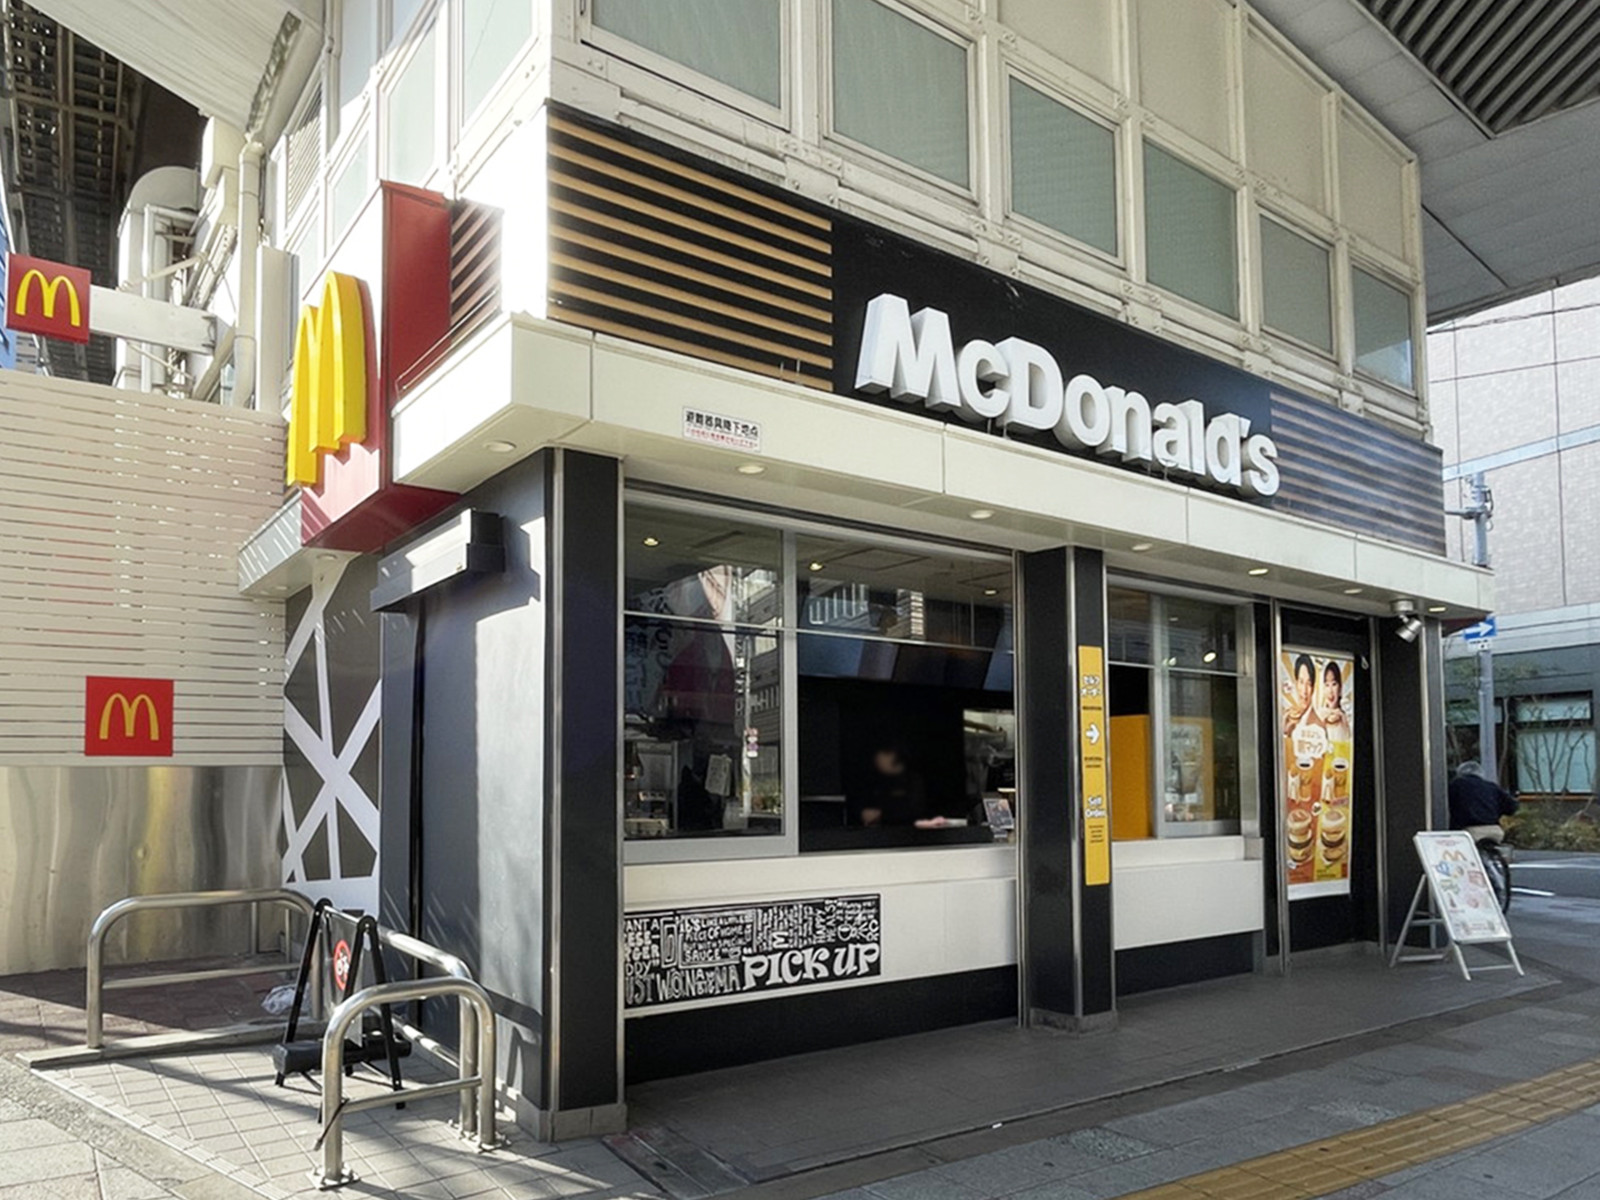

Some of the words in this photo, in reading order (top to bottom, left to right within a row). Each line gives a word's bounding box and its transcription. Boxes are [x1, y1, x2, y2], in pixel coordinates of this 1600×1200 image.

[854, 293, 1281, 497] McDonald's
[742, 948, 830, 990] PICK
[833, 942, 880, 977] UP
